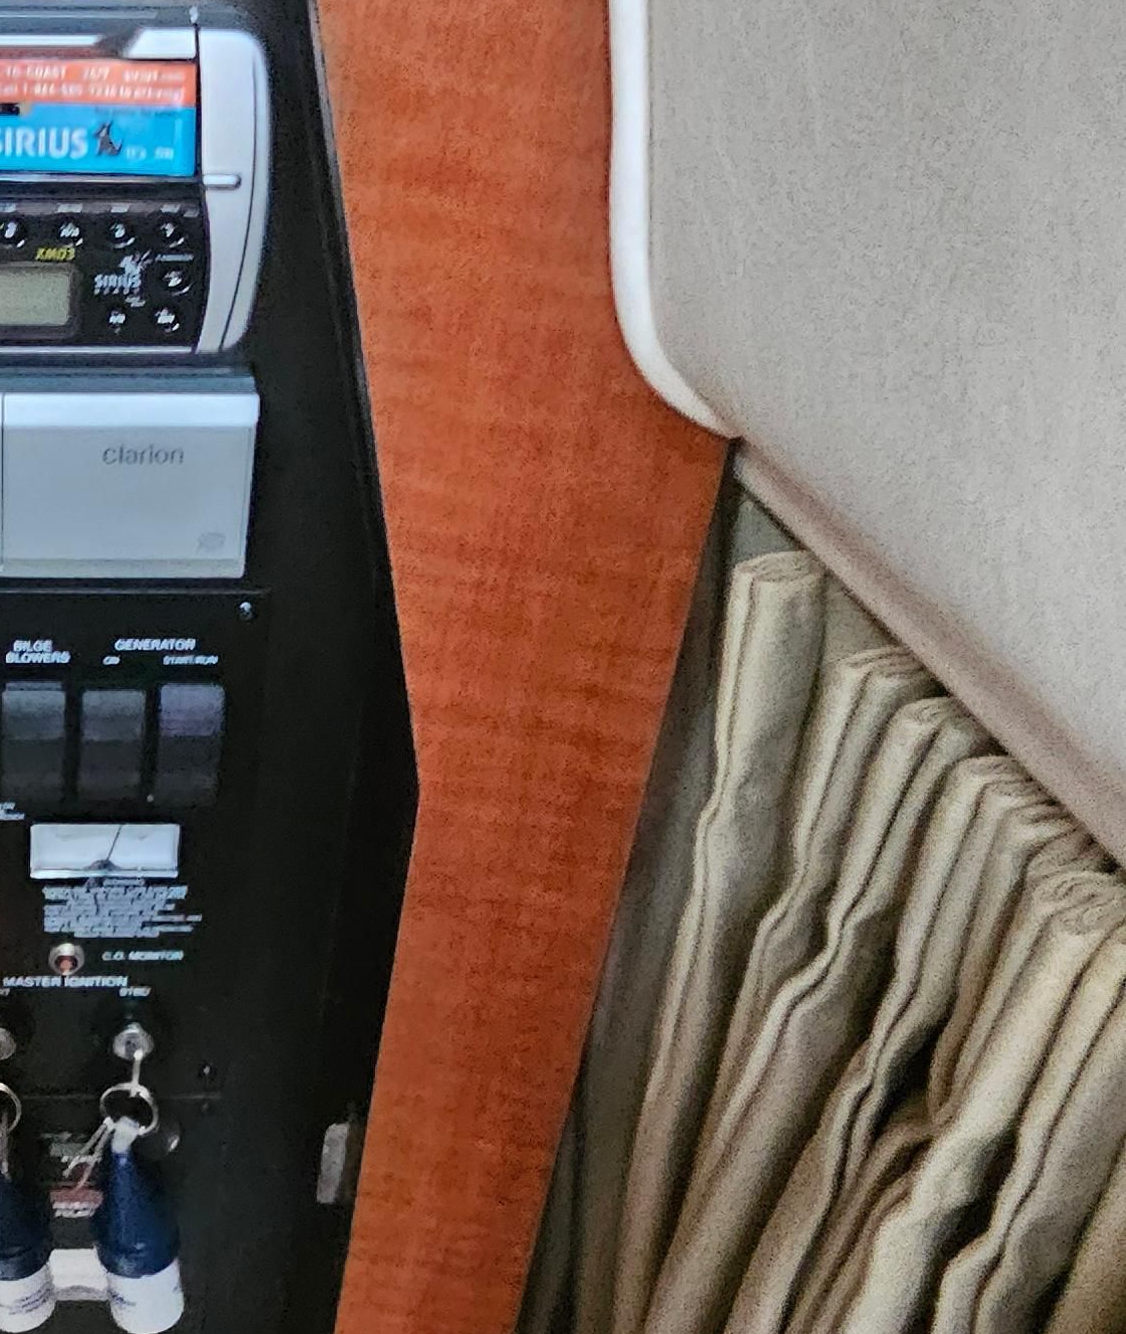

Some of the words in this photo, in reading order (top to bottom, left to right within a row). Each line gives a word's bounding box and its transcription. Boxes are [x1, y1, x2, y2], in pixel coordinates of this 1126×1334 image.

[13, 640, 53, 652] BILGE
[114, 638, 196, 651] GENERATOR
[6, 651, 71, 663] BLOWERS
[128, 950, 185, 961] MONITOR
[2, 976, 62, 987] MASTER
[64, 976, 128, 987] IGNITION
